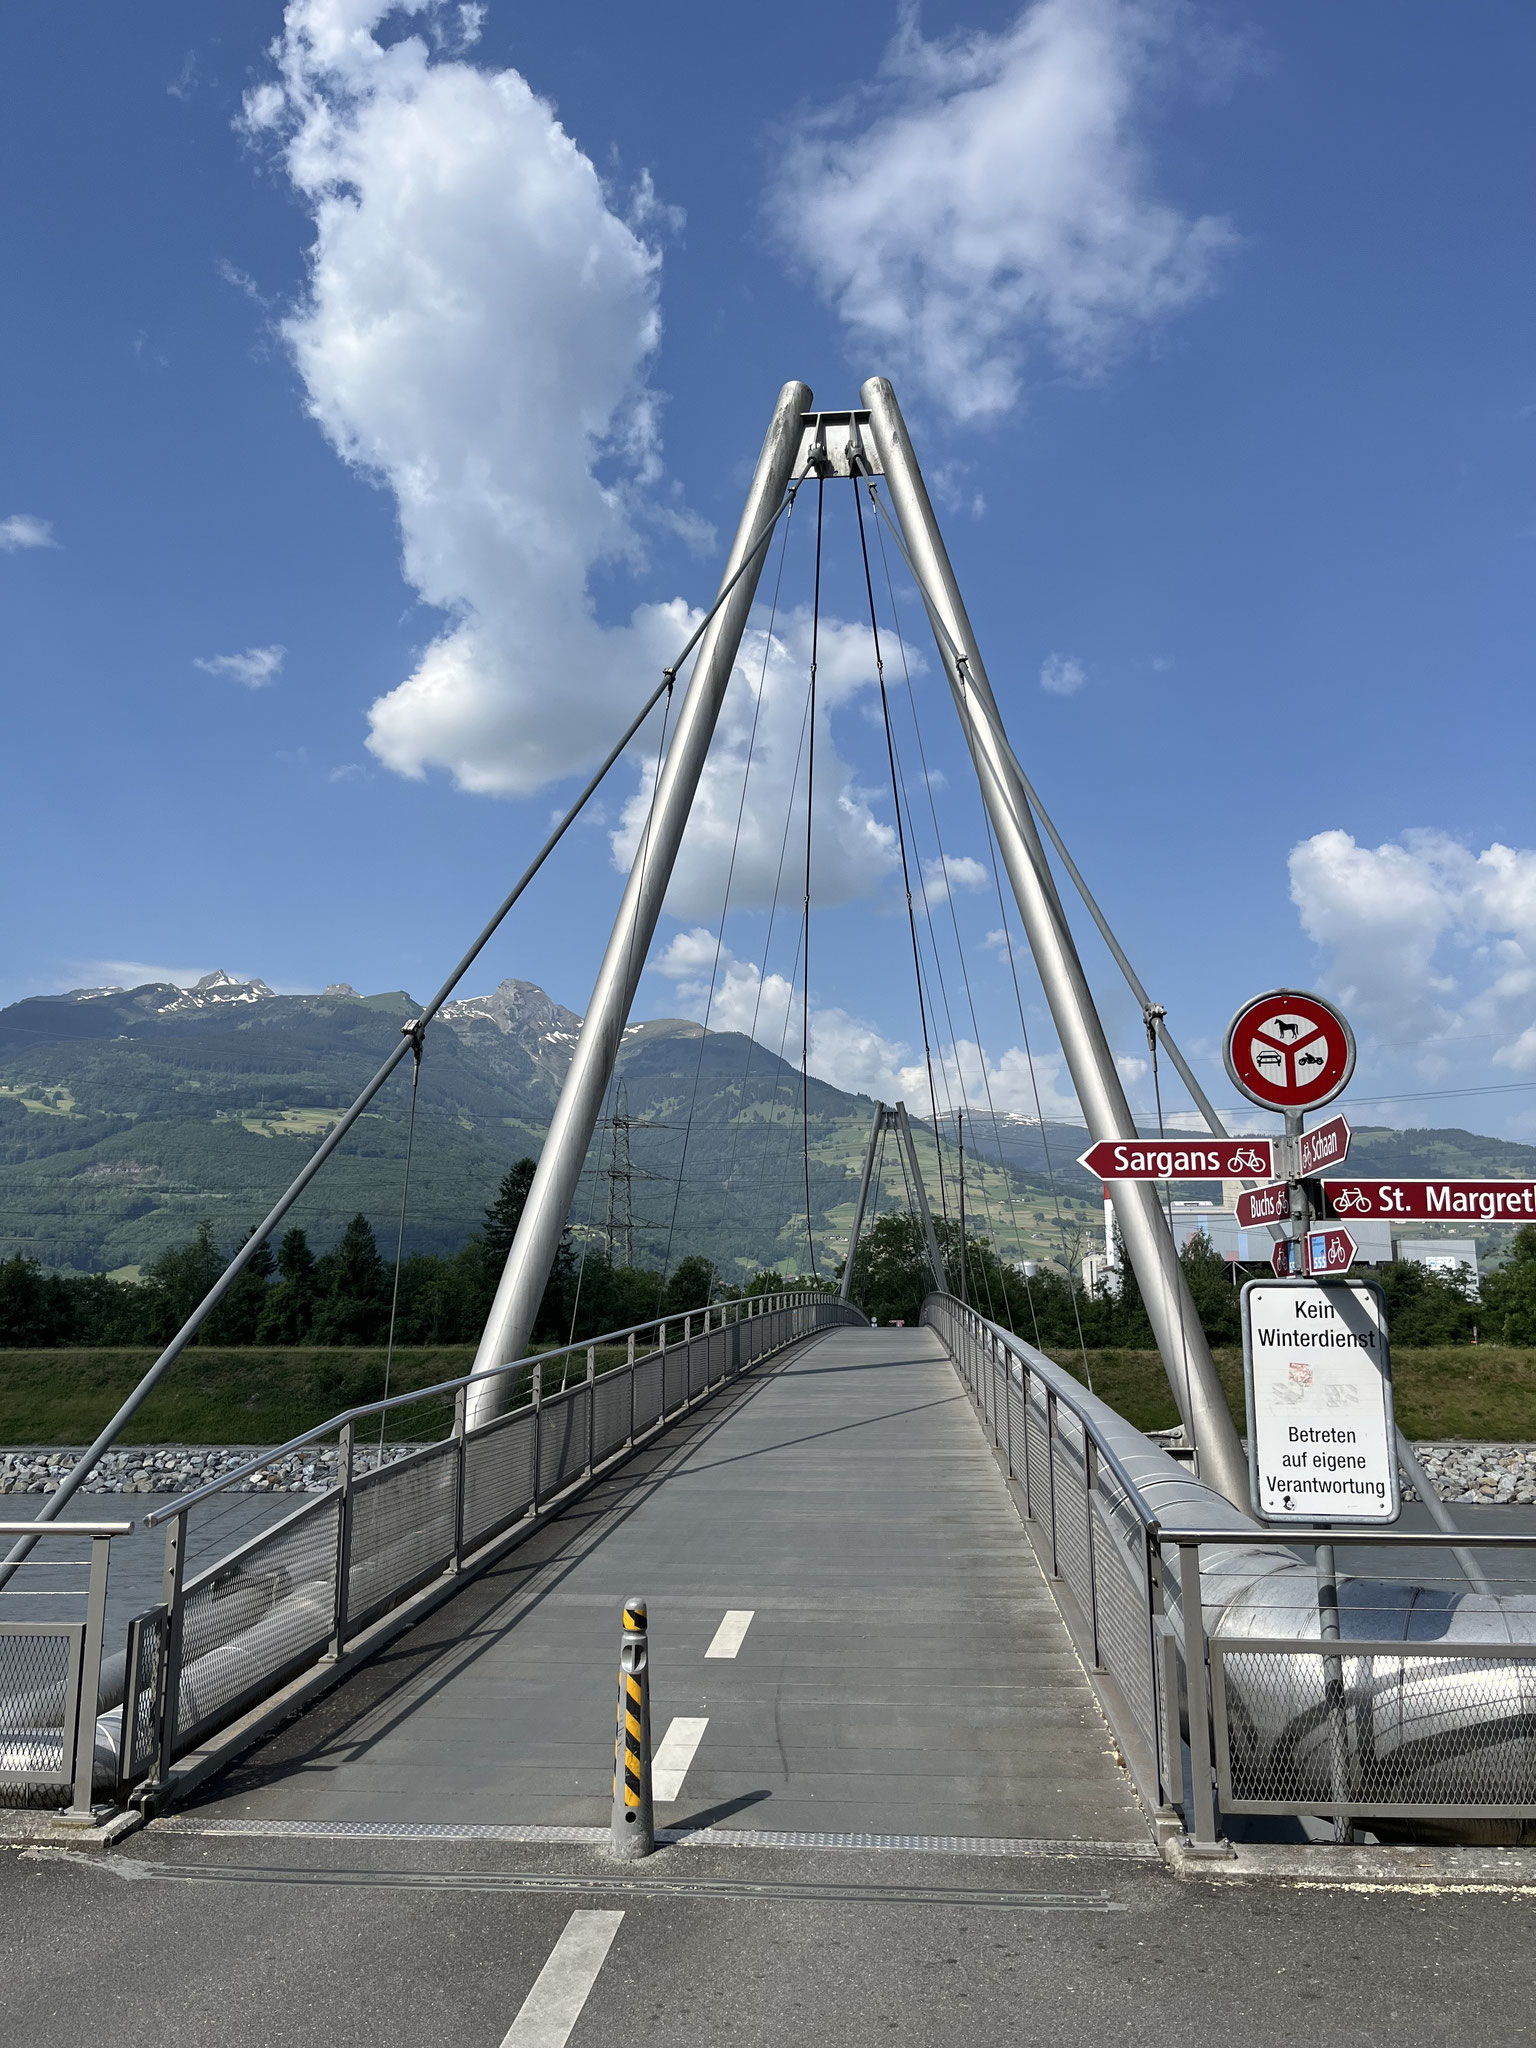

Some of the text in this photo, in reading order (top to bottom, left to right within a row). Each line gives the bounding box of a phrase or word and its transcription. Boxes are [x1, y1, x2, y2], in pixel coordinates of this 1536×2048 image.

[1311, 1130, 1338, 1163] Schaan
[1113, 1146, 1220, 1178] Sargans
[1250, 1190, 1275, 1219] Buchs
[1378, 1185, 1536, 1219] St. Margret
[1295, 1300, 1335, 1319] Kein
[1257, 1328, 1376, 1348] Winterdienst
[1288, 1426, 1356, 1444] Betreten
[1282, 1451, 1367, 1472] auf eigene
[1266, 1475, 1386, 1499] Verantwortung
